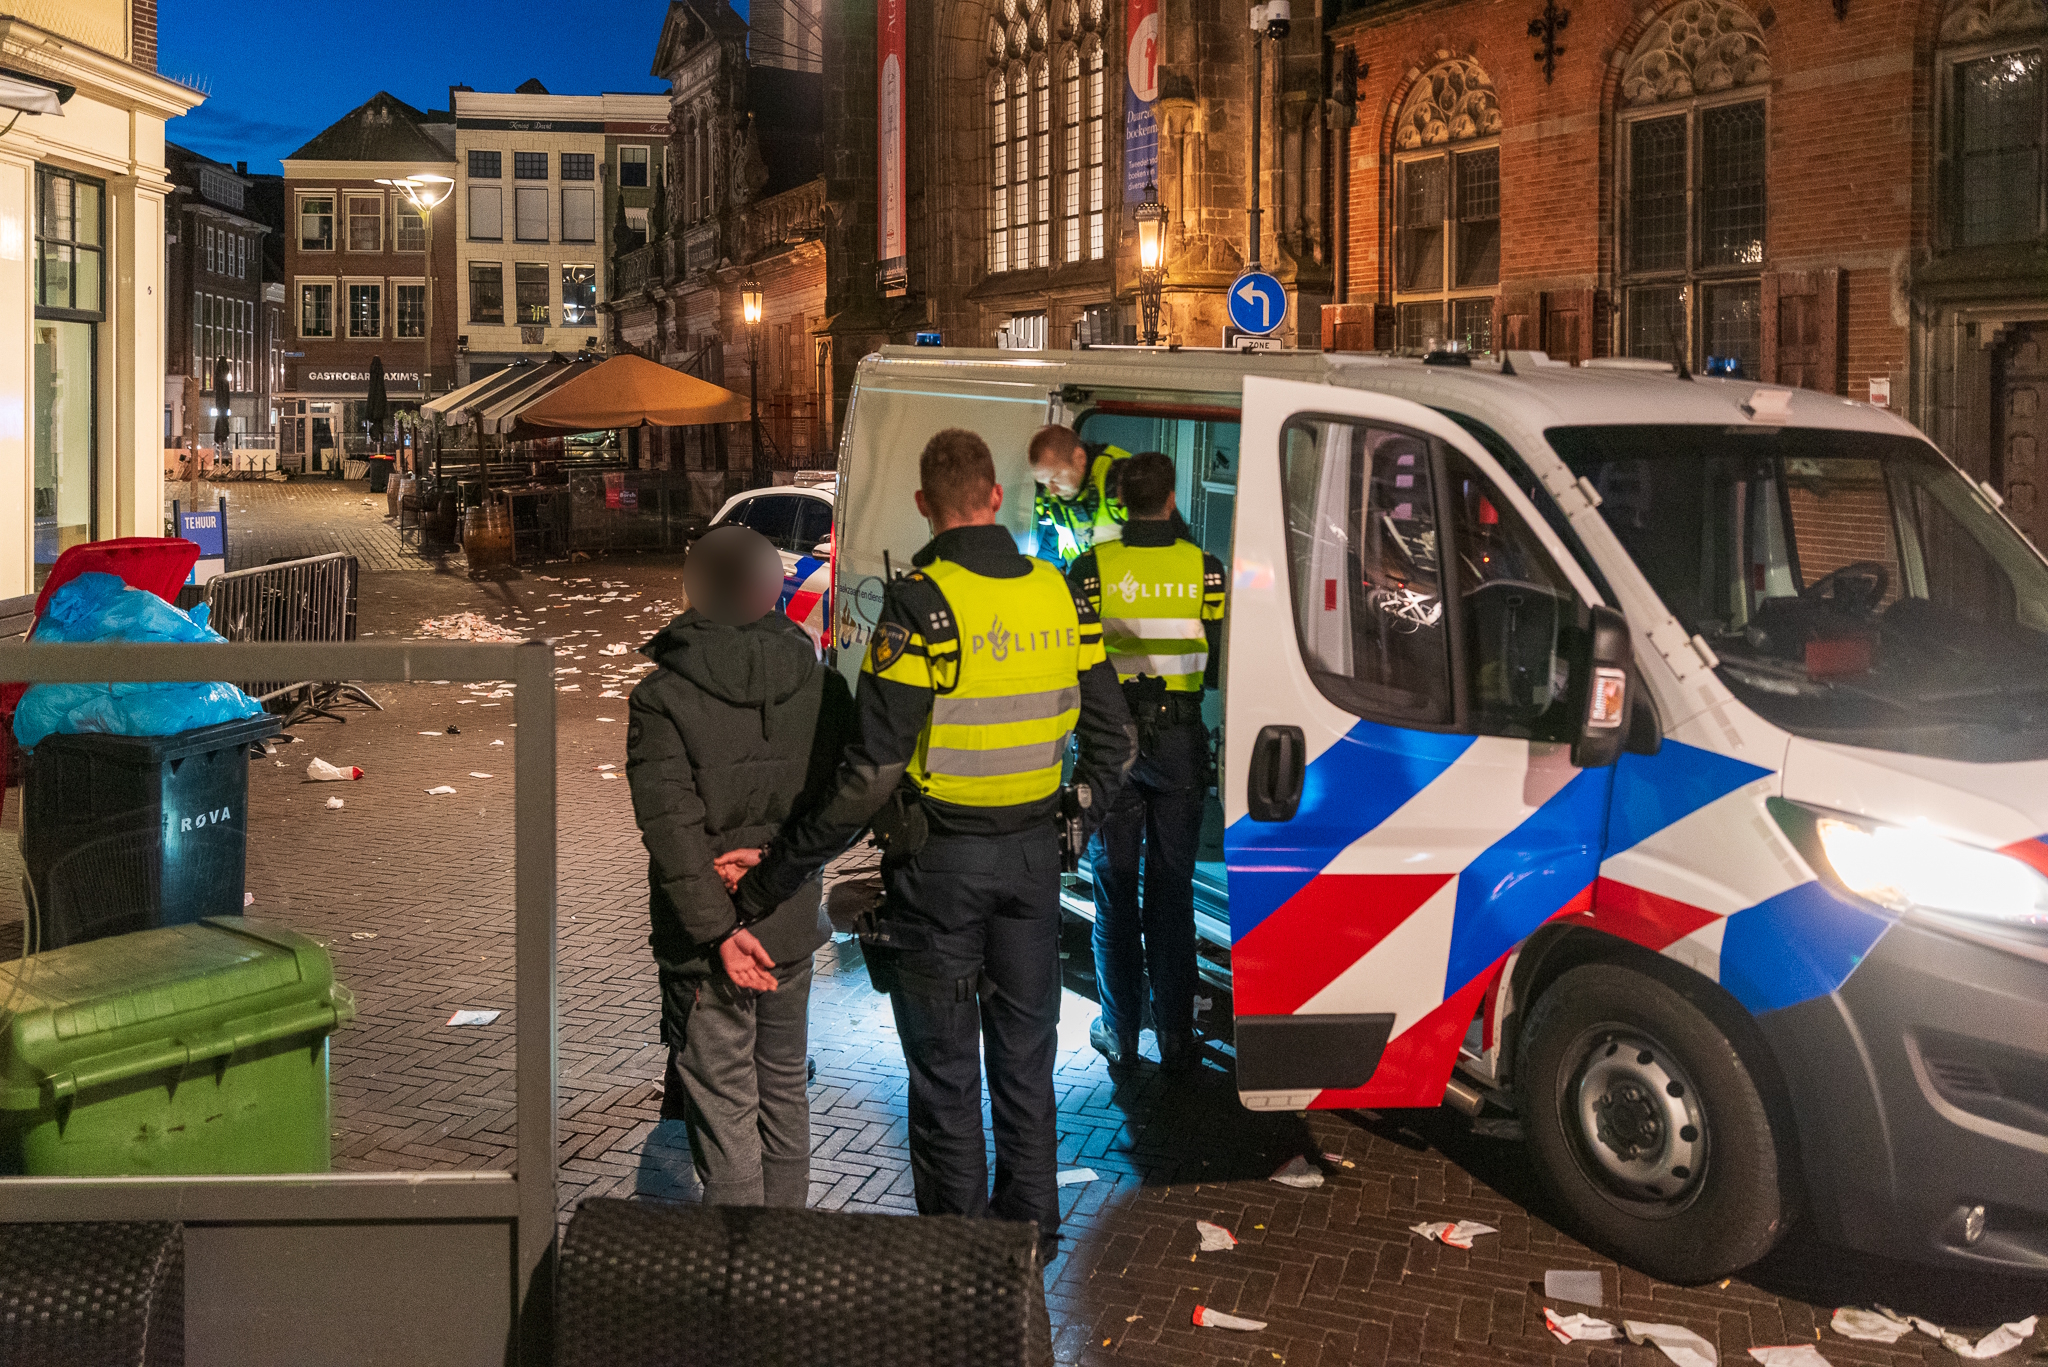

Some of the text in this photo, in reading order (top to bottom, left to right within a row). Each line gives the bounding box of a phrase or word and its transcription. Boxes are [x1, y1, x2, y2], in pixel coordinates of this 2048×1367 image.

[1248, 341, 1270, 349] ZONE
[308, 371, 419, 381] GASTROBAR AXIM'S
